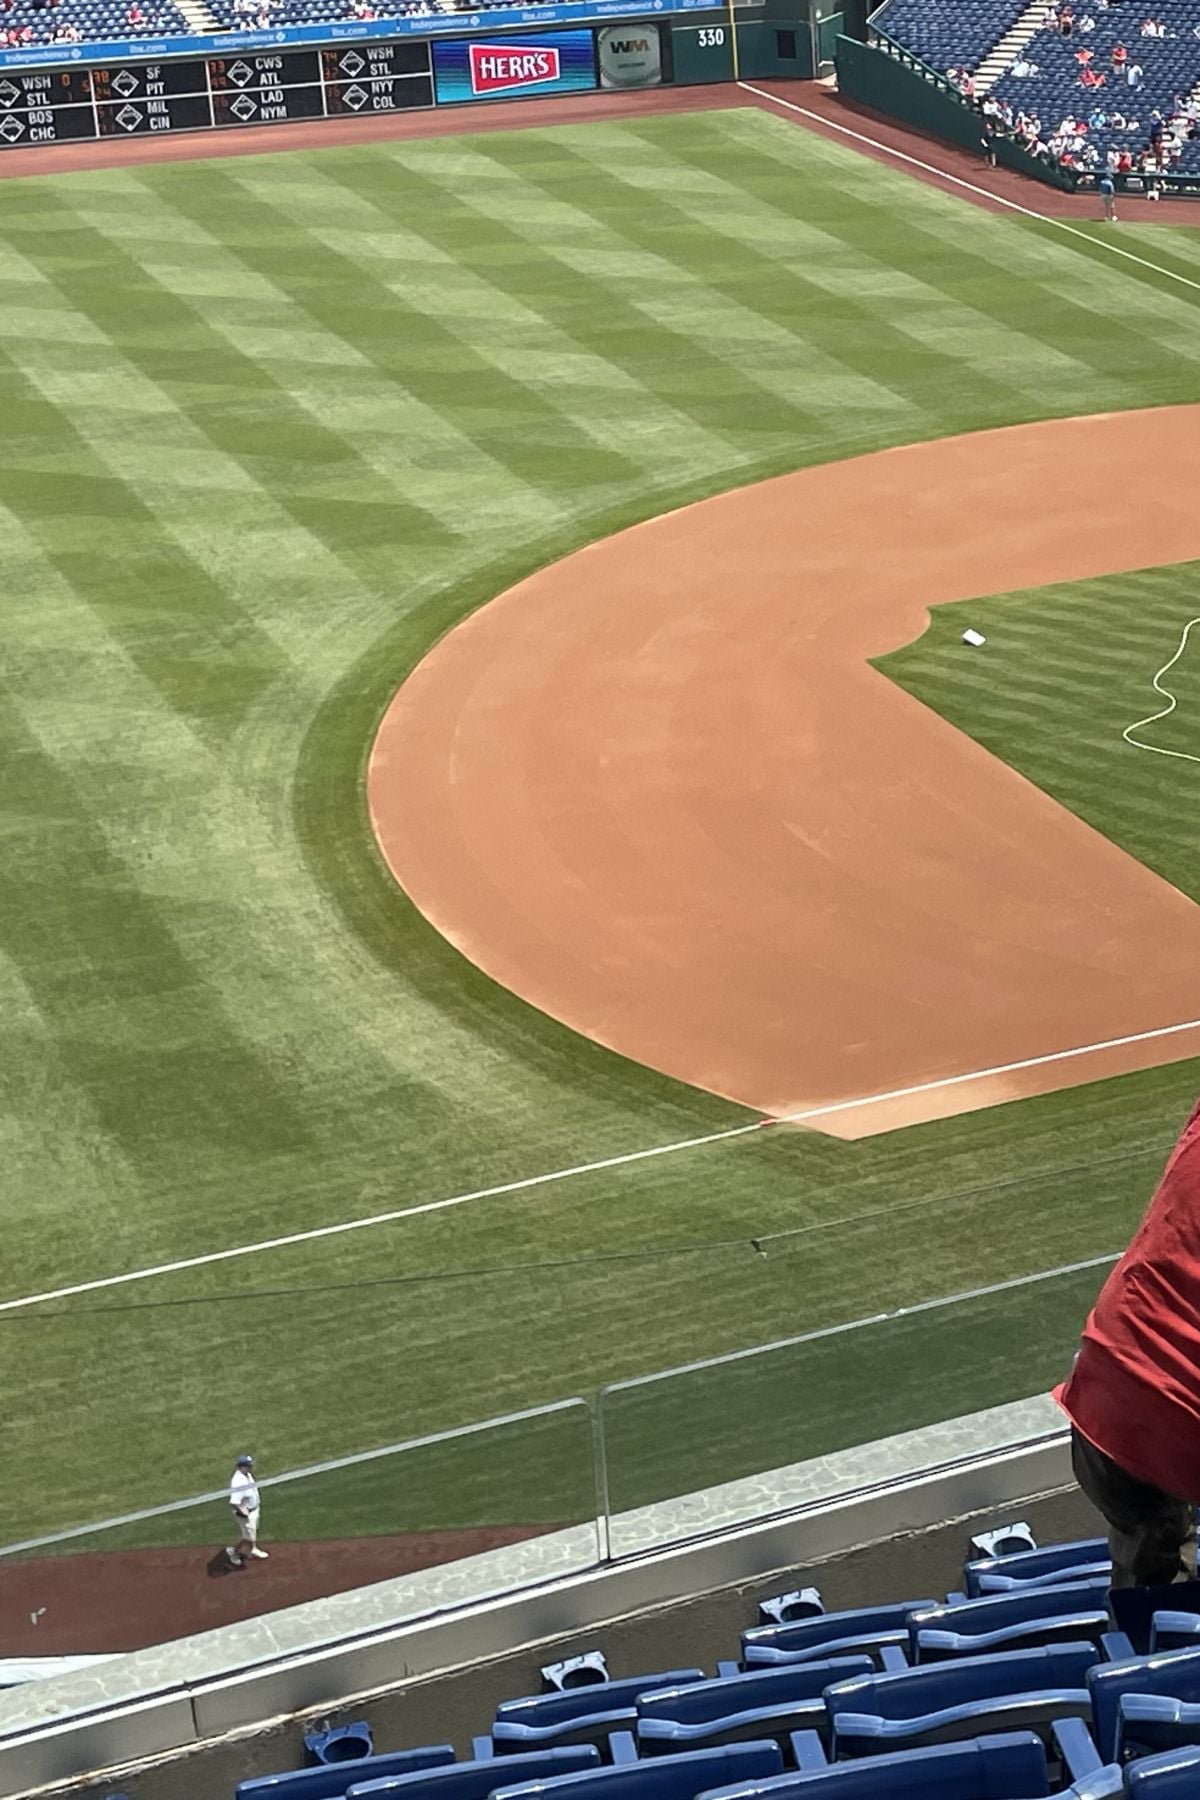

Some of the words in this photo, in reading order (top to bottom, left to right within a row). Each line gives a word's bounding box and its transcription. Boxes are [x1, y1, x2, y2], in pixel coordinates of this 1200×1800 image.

[697, 28, 725, 47] 330
[366, 46, 395, 60] WSH
[610, 39, 650, 53] WM
[255, 56, 283, 70] CWS
[370, 62, 392, 76] STL
[479, 53, 549, 79] HERR'S
[146, 66, 161, 80] SF
[260, 72, 282, 85] ATL
[22, 75, 52, 90] WSH
[146, 82, 165, 95] PIT
[371, 80, 394, 94] NYY
[27, 92, 50, 106] STL
[260, 90, 284, 104] LAD
[373, 96, 396, 109] COL
[147, 101, 169, 114] MIL
[261, 106, 288, 119] NYM
[28, 110, 54, 124] BOS
[149, 116, 171, 129] CIN
[30, 126, 56, 141] CHC
